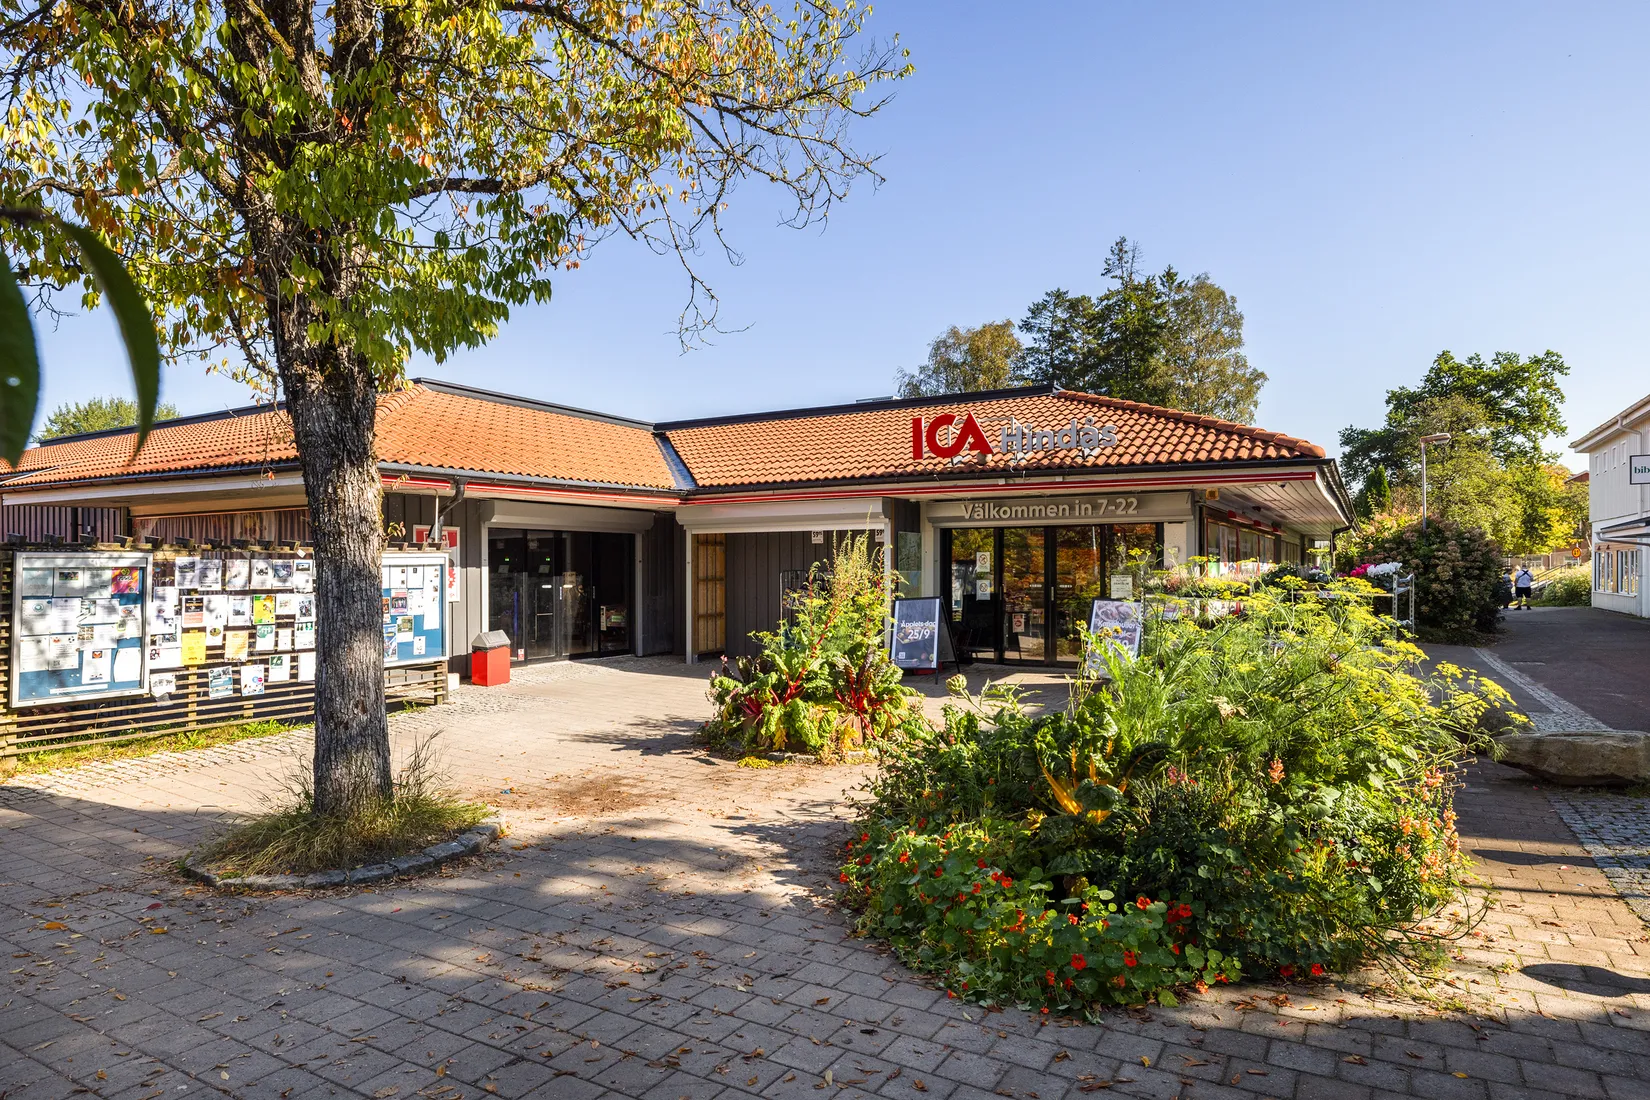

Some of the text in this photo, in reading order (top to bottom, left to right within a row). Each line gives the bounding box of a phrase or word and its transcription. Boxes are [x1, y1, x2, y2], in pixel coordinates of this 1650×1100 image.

[912, 411, 1119, 460] ICA Hindås
[960, 497, 1138, 520] Välkommen in 7-22
[907, 629, 930, 640] 25/9
